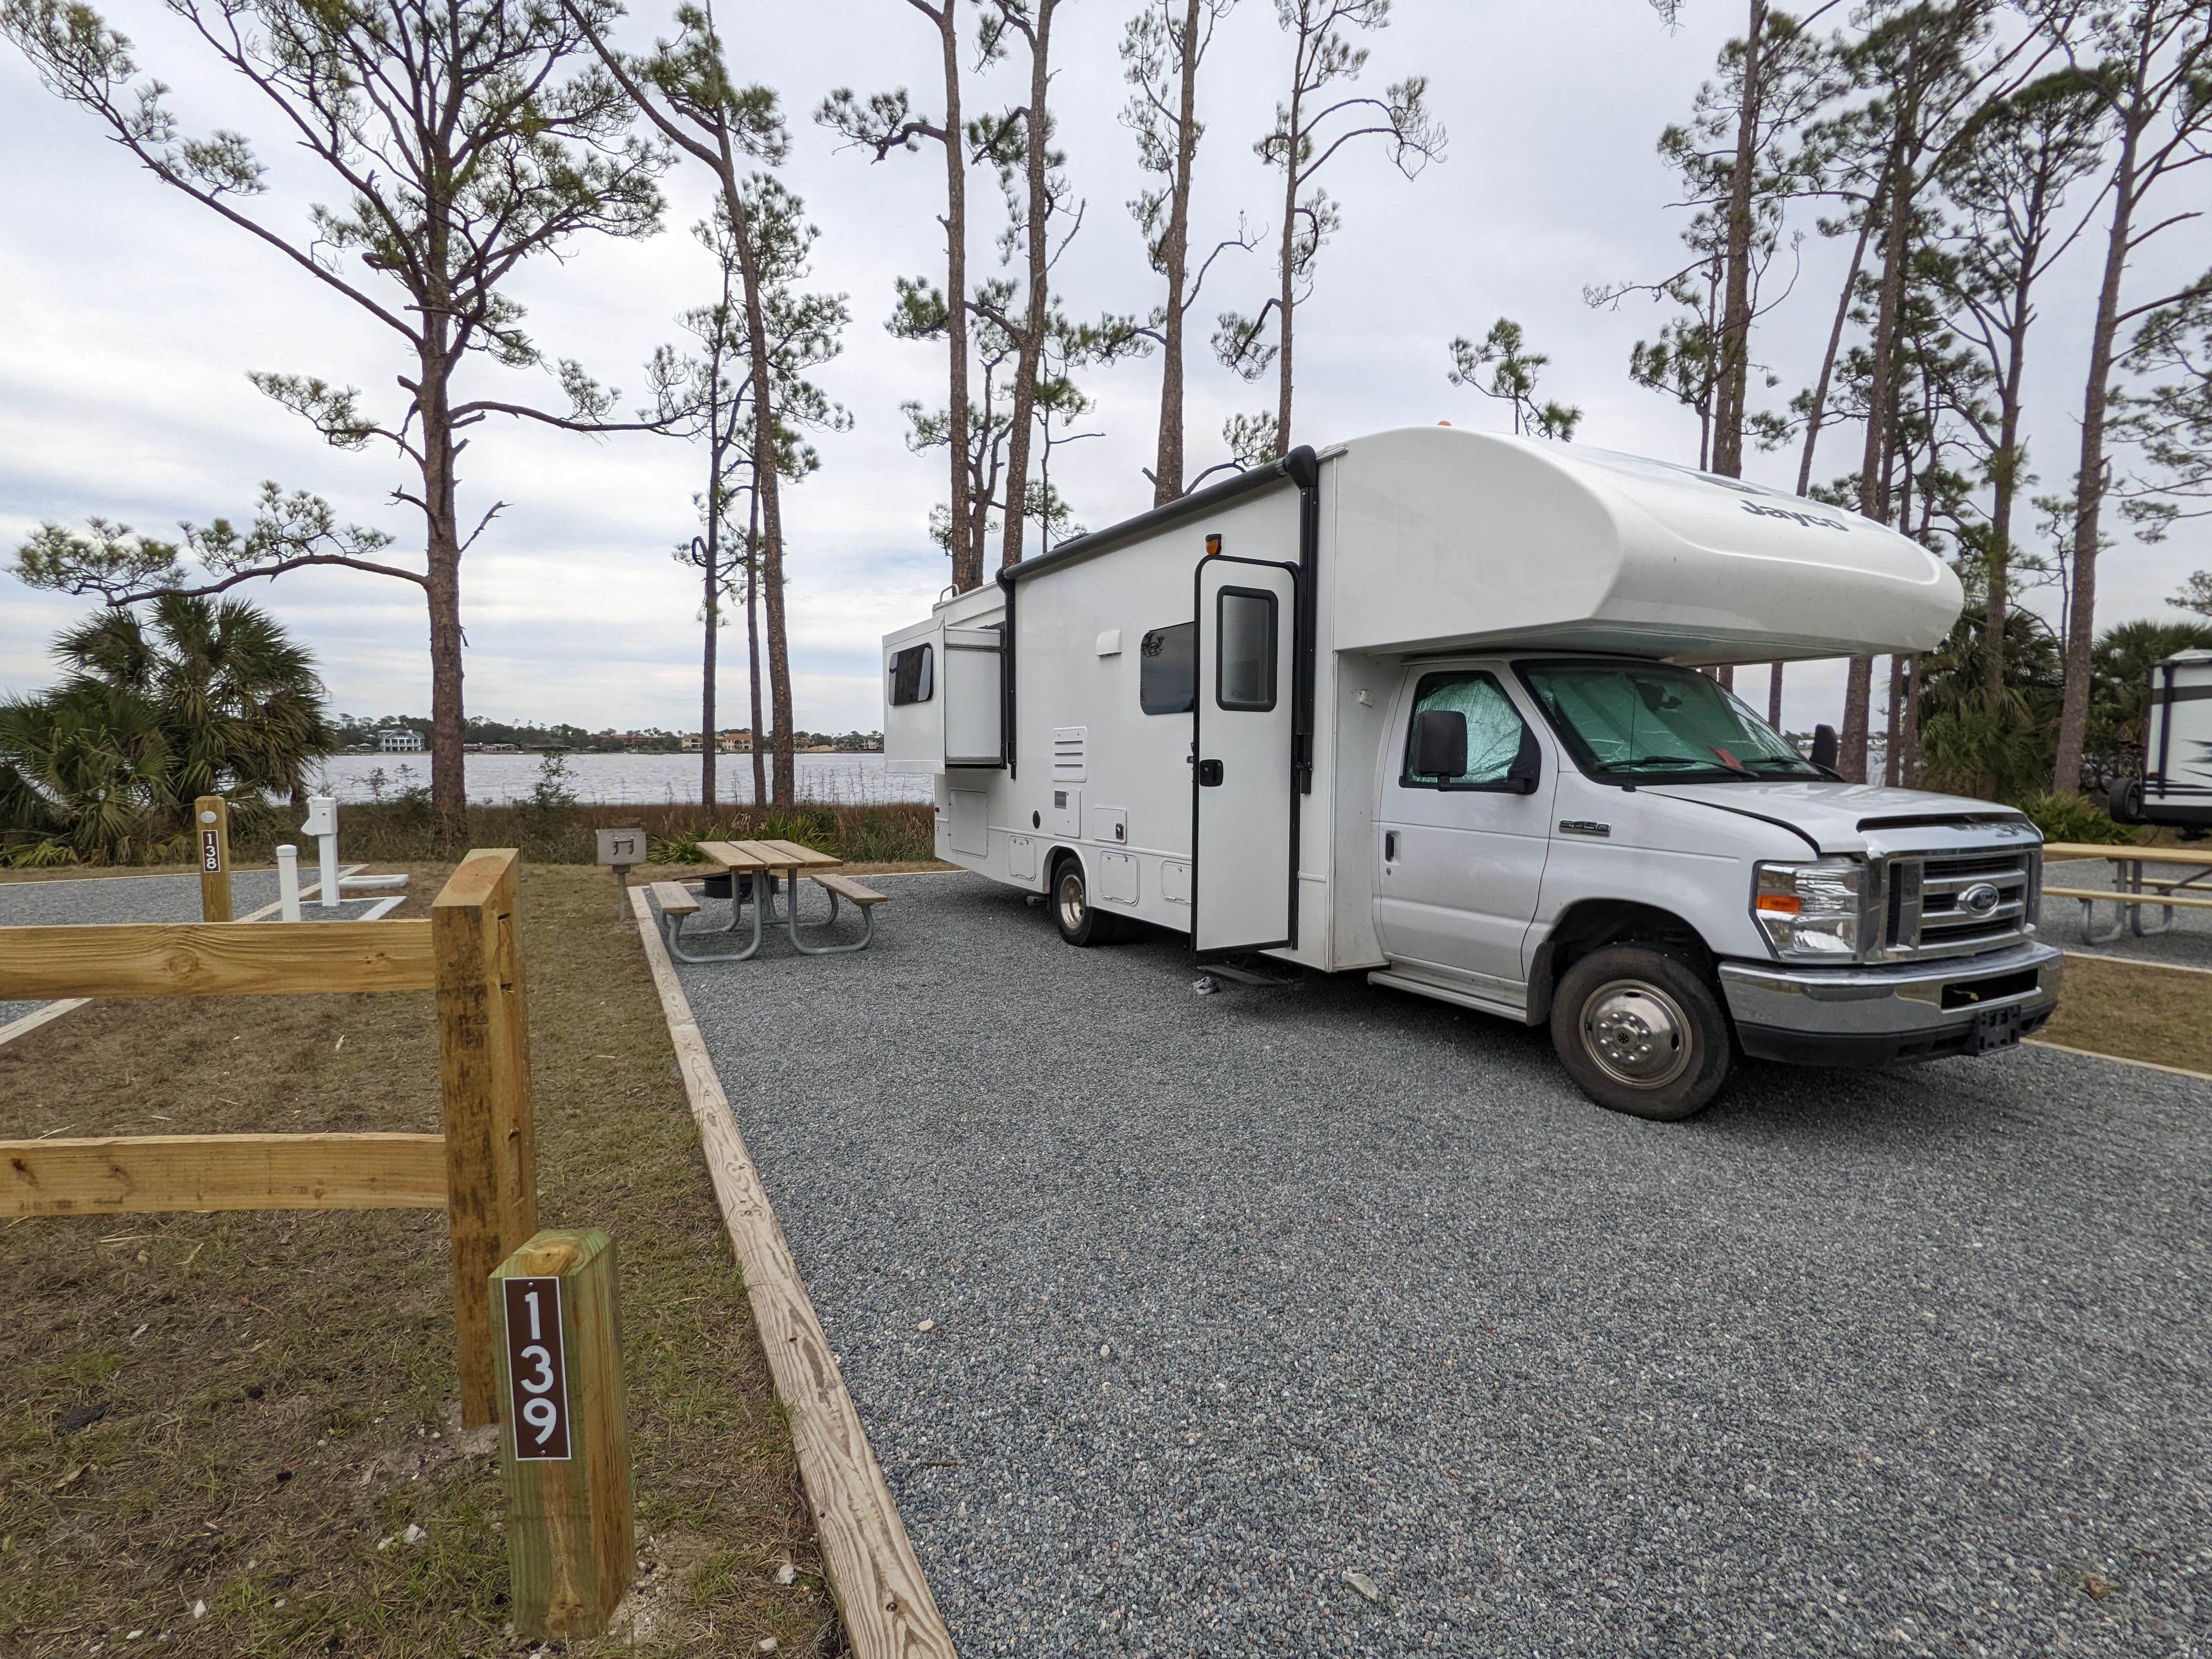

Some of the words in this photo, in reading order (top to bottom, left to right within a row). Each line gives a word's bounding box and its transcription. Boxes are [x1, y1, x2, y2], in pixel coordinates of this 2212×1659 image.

[1740, 500, 1849, 532] Jayco
[206, 833, 217, 869] 138
[521, 1291, 557, 1444] 139
